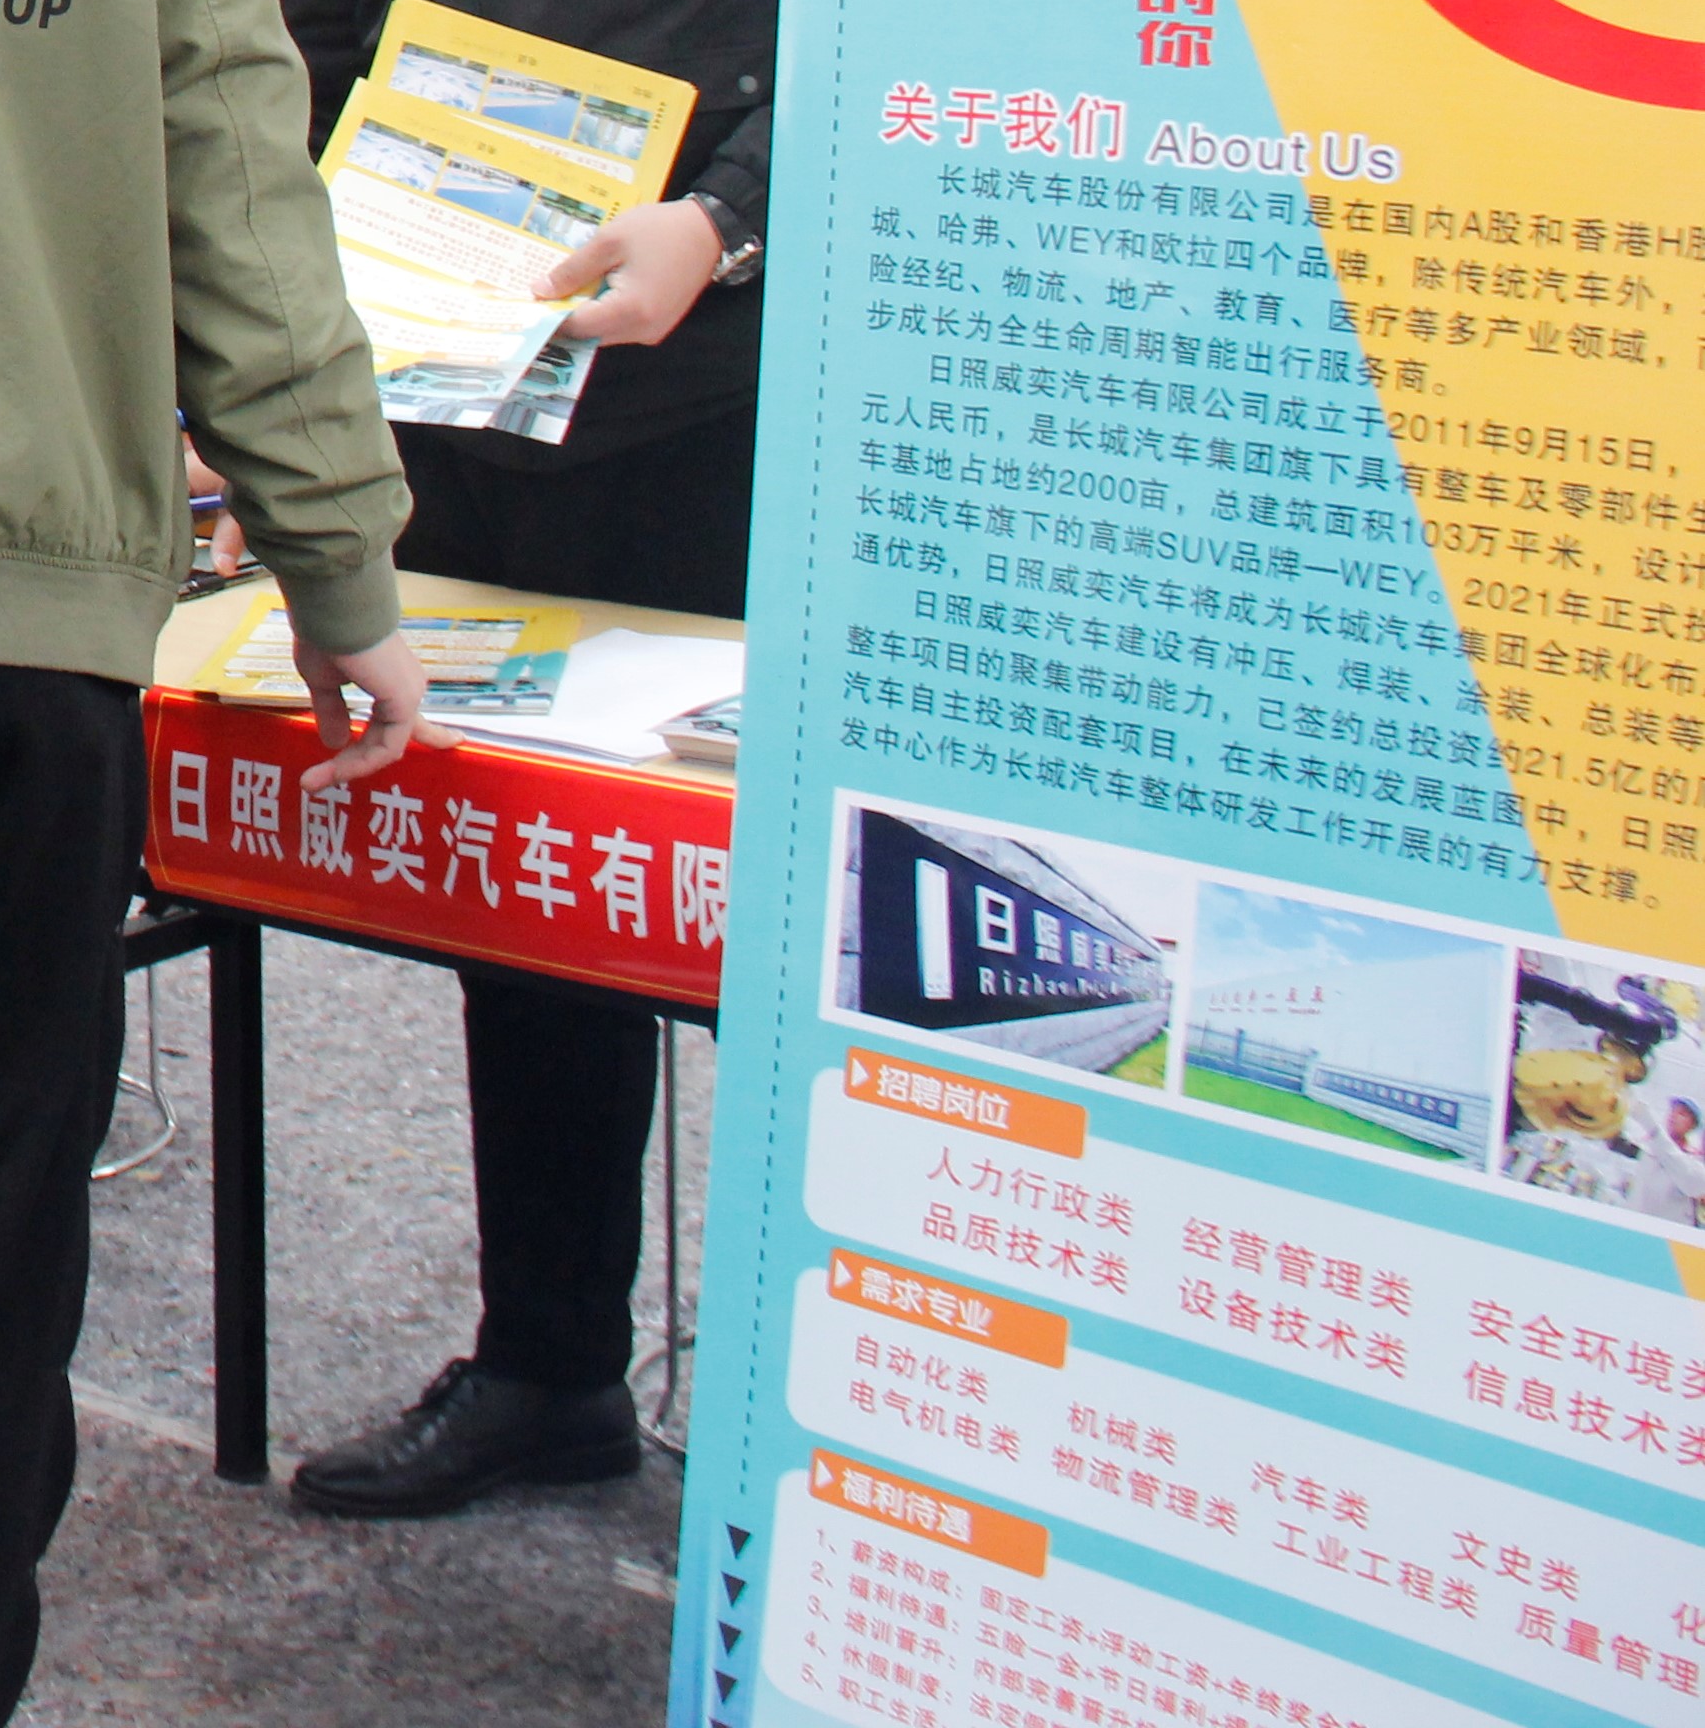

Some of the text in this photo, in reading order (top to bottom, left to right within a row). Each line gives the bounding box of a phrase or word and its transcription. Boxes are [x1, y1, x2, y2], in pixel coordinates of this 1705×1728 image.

[880, 83, 1397, 181] 关于我们 About Us
[868, 253, 1705, 371] 险经纪、物流、地产、教育、医疗等多产业领域，
[871, 205, 1705, 316] 城、哈弗、WEY和欧拉四个品牌，除传统汽车外，
[866, 300, 1449, 397] 步成长为全生命周期智能出行服务商。
[852, 531, 1705, 697] 通优势，日照威奕汽车将成为长城汽车集团全球化布
[168, 749, 730, 951] 日照威奕汽车有限
[840, 717, 1661, 910] 发中心作为长城汽车整体研发工作开展的有力支撑。
[876, 1065, 1011, 1130] 招聘岗位
[858, 1266, 994, 1338] 需求专业
[922, 1201, 1130, 1295] 品质技术类
[1178, 1276, 1409, 1380] 设备技术类
[927, 1146, 1135, 1236] 人力行政类
[1181, 1216, 1415, 1317] 经营管理类
[840, 1466, 975, 1545] 福利待遇
[849, 1379, 1703, 1699] 电气机电类 物流管理类 工业工程类 质量管理
[854, 1334, 991, 1405] 自动化类
[1067, 1401, 1178, 1466] 机械类
[1250, 1461, 1370, 1530] 汽车类
[1450, 1529, 1581, 1603] 文史类
